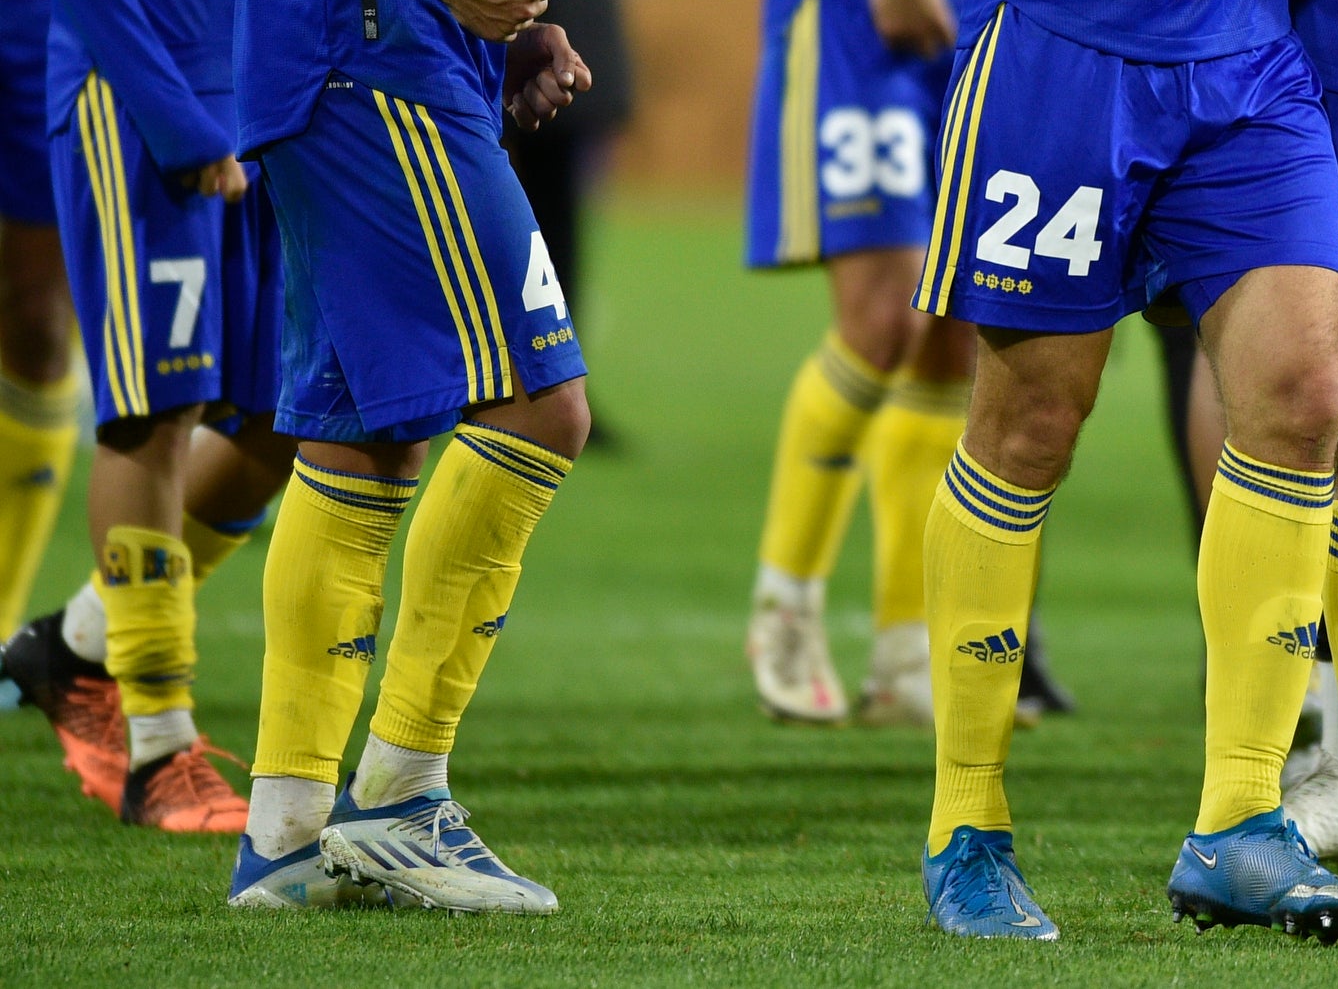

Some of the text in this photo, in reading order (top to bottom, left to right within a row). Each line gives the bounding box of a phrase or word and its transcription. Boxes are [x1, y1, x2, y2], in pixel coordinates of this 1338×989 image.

[821, 108, 924, 197] 33
[976, 169, 1103, 276] 24
[150, 258, 206, 348] 7
[522, 230, 566, 320] 4
